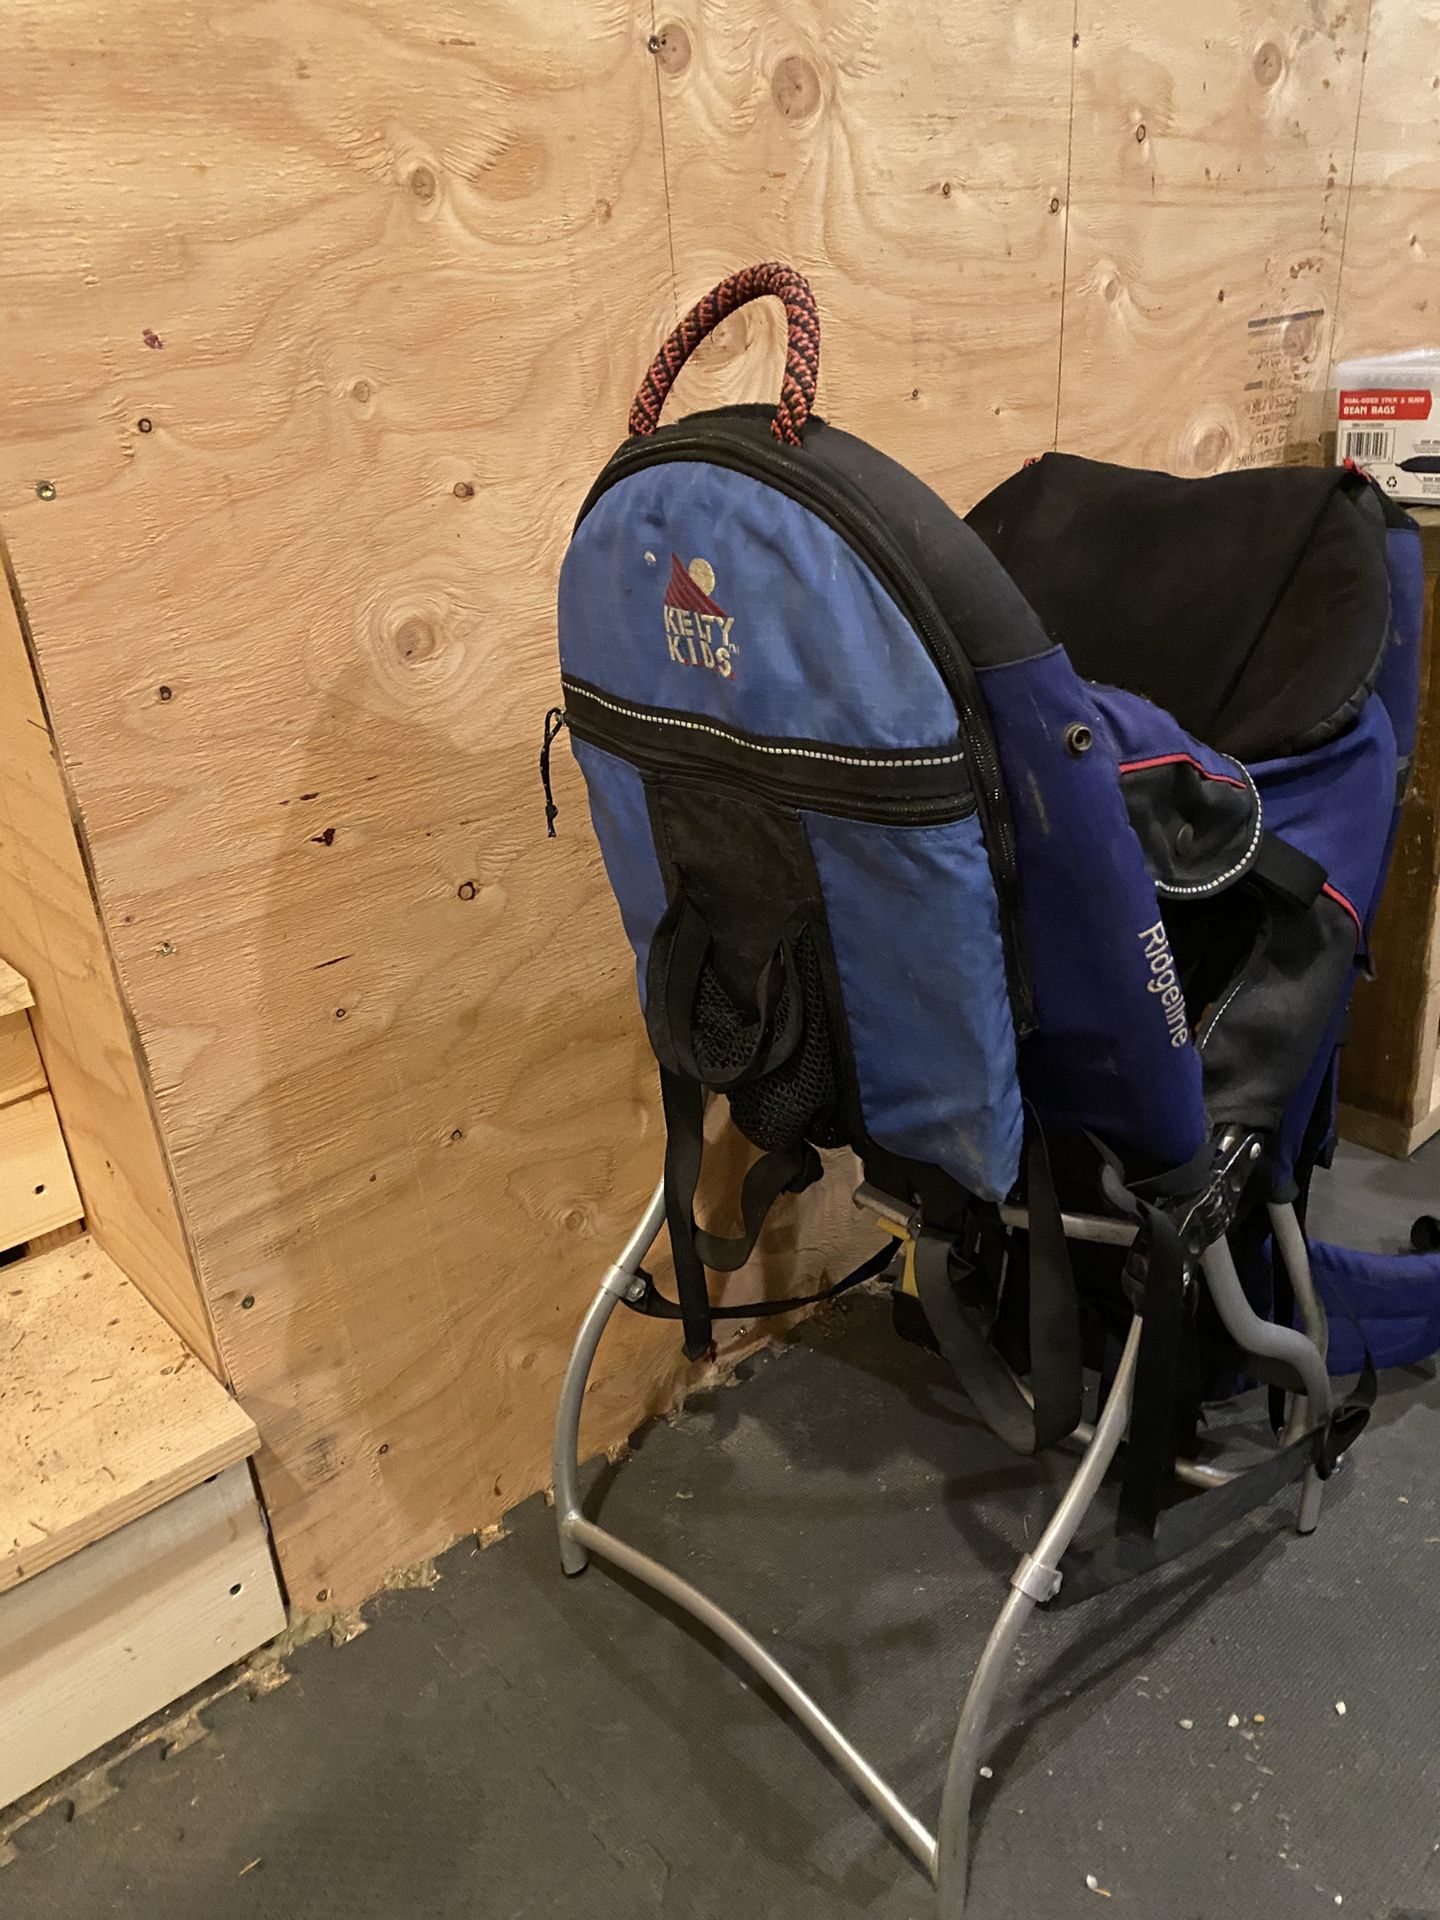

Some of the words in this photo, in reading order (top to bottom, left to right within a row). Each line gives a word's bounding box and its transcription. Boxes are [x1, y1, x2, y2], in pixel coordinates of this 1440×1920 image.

[1343, 405, 1368, 415] BEAN
[1371, 405, 1396, 415] BAGS
[664, 605, 735, 646] KELTY
[666, 635, 731, 678] KIDS
[1137, 920, 1188, 1048] Ridgeline
